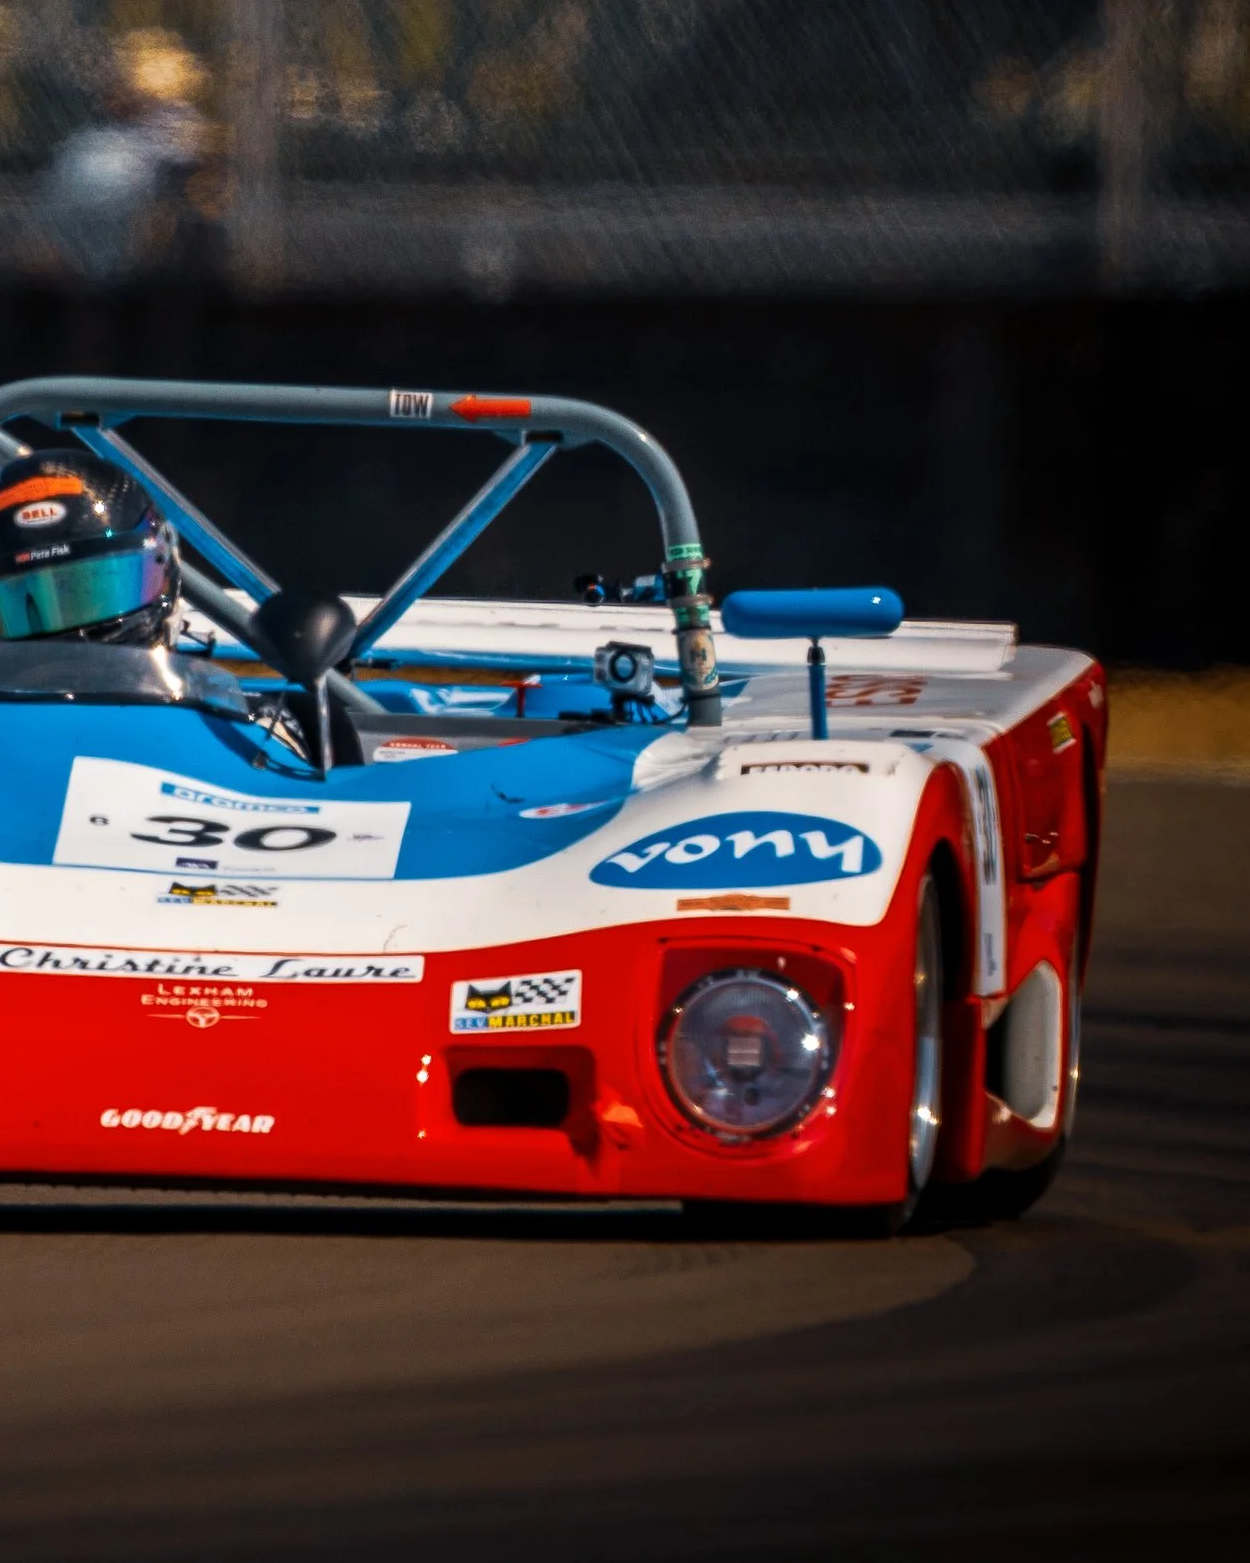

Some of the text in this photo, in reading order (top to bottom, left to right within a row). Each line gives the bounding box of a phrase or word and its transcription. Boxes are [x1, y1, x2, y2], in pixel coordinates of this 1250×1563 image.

[394, 392, 430, 415] TOW
[22, 507, 57, 520] BELL
[30, 544, 70, 561] Pete Fisk
[131, 815, 337, 852] 30
[259, 957, 416, 980] Laure
[158, 983, 254, 997] LEXHAM
[141, 994, 268, 1008] ENGINEERING
[488, 1011, 575, 1028] MARCHAL
[100, 1105, 276, 1136] GOODYEAR
